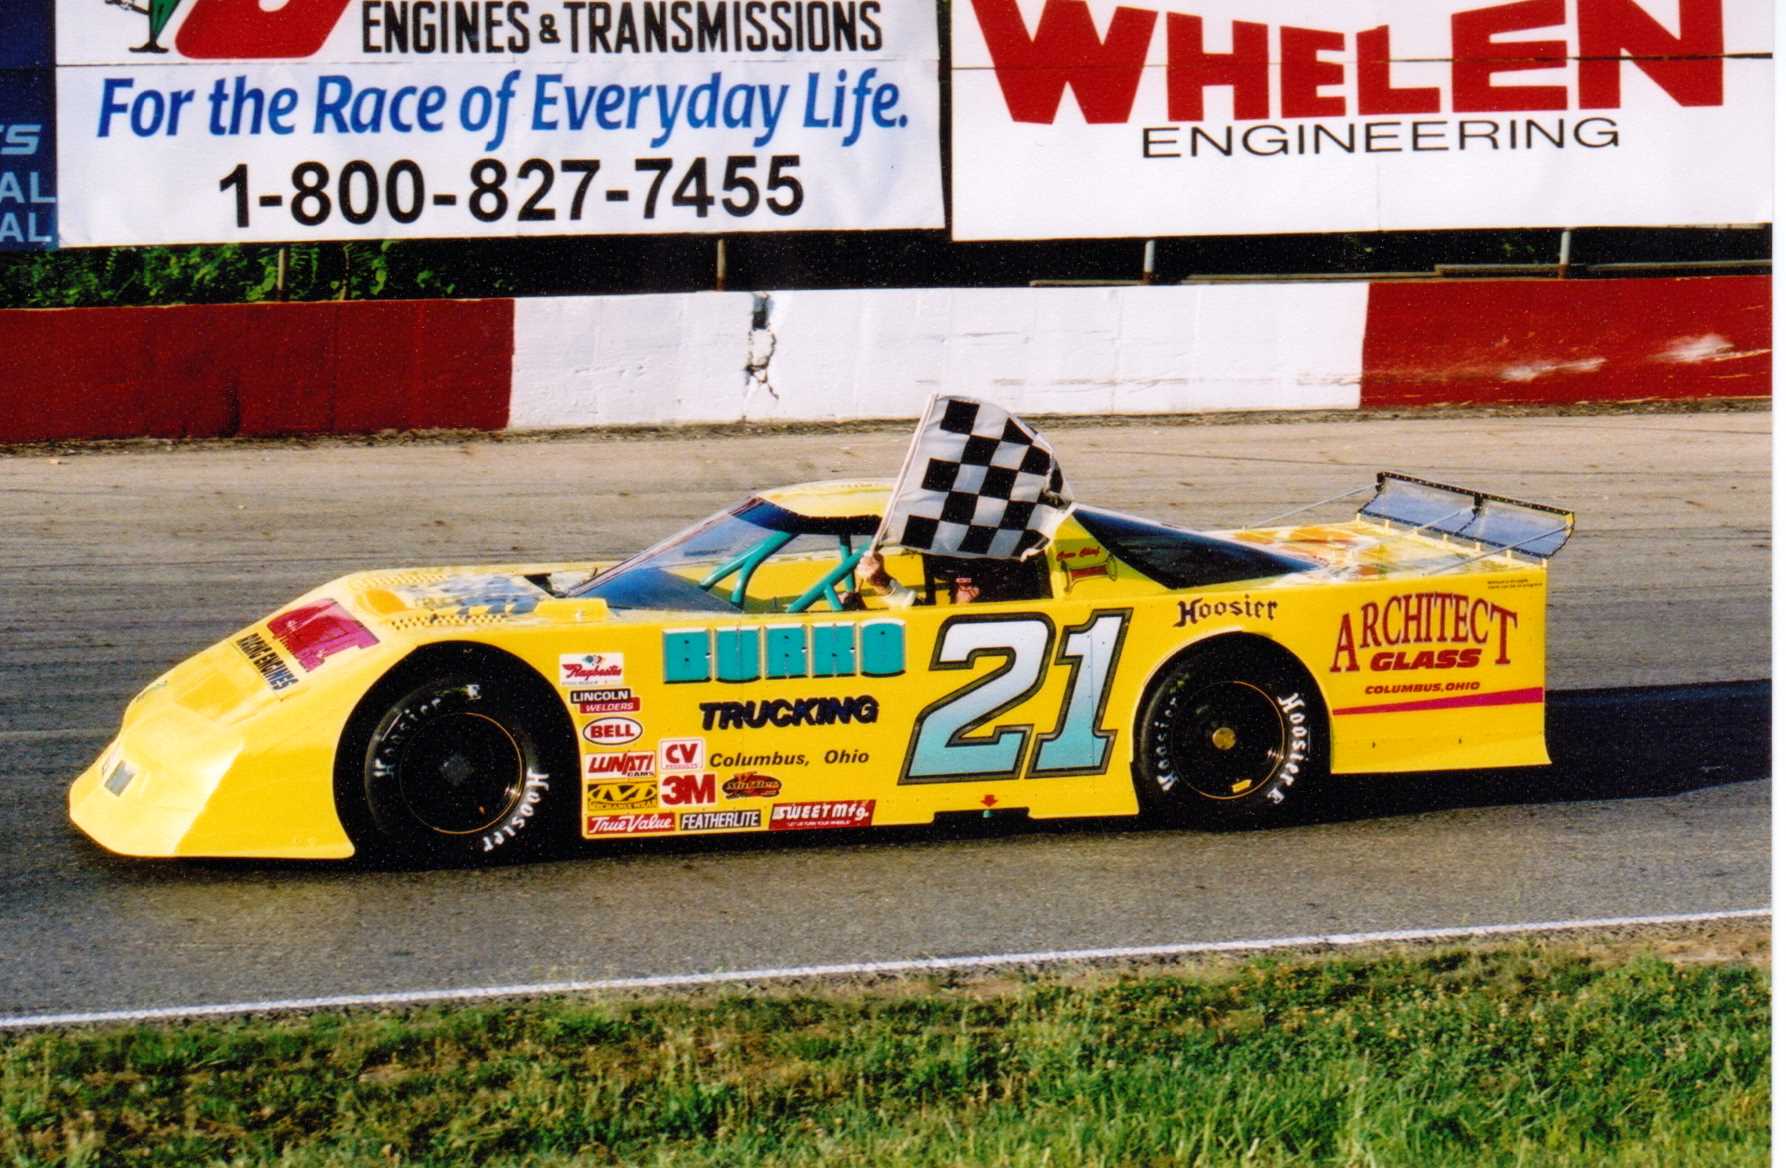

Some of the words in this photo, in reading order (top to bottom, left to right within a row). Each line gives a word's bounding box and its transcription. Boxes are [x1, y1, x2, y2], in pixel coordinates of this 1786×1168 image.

[363, 1, 530, 53] ENGINES
[538, 13, 560, 45] &
[570, 0, 882, 52] TRANSMISSIONS
[970, 0, 1724, 124] WHELEN
[97, 77, 195, 137] For
[207, 75, 298, 136] the
[313, 75, 446, 134] Race
[458, 70, 521, 152] of
[531, 71, 789, 148] Everyday
[802, 68, 908, 147] Life.
[1142, 118, 1620, 159] ENGINEERING
[219, 155, 805, 228] 1-800-827-7455
[1172, 593, 1278, 627] Hoosier
[1329, 591, 1518, 672] ARCHITECT
[1369, 648, 1483, 671] GLASS
[572, 691, 629, 702] LINCOLN
[585, 702, 635, 712] WELDERS
[897, 607, 1133, 786] 21
[699, 695, 880, 731] TRUCKING
[591, 724, 635, 738] BELL
[1277, 692, 1309, 787] Hoosier
[588, 752, 654, 774] LUNATI
[666, 743, 698, 764] CV
[709, 751, 810, 768] Columbus,
[824, 749, 869, 765] Ohio
[661, 774, 716, 805] 3M
[681, 812, 759, 829] FEATHERLITE
[772, 804, 833, 820] SWEET
[833, 803, 870, 821] Mfg.
